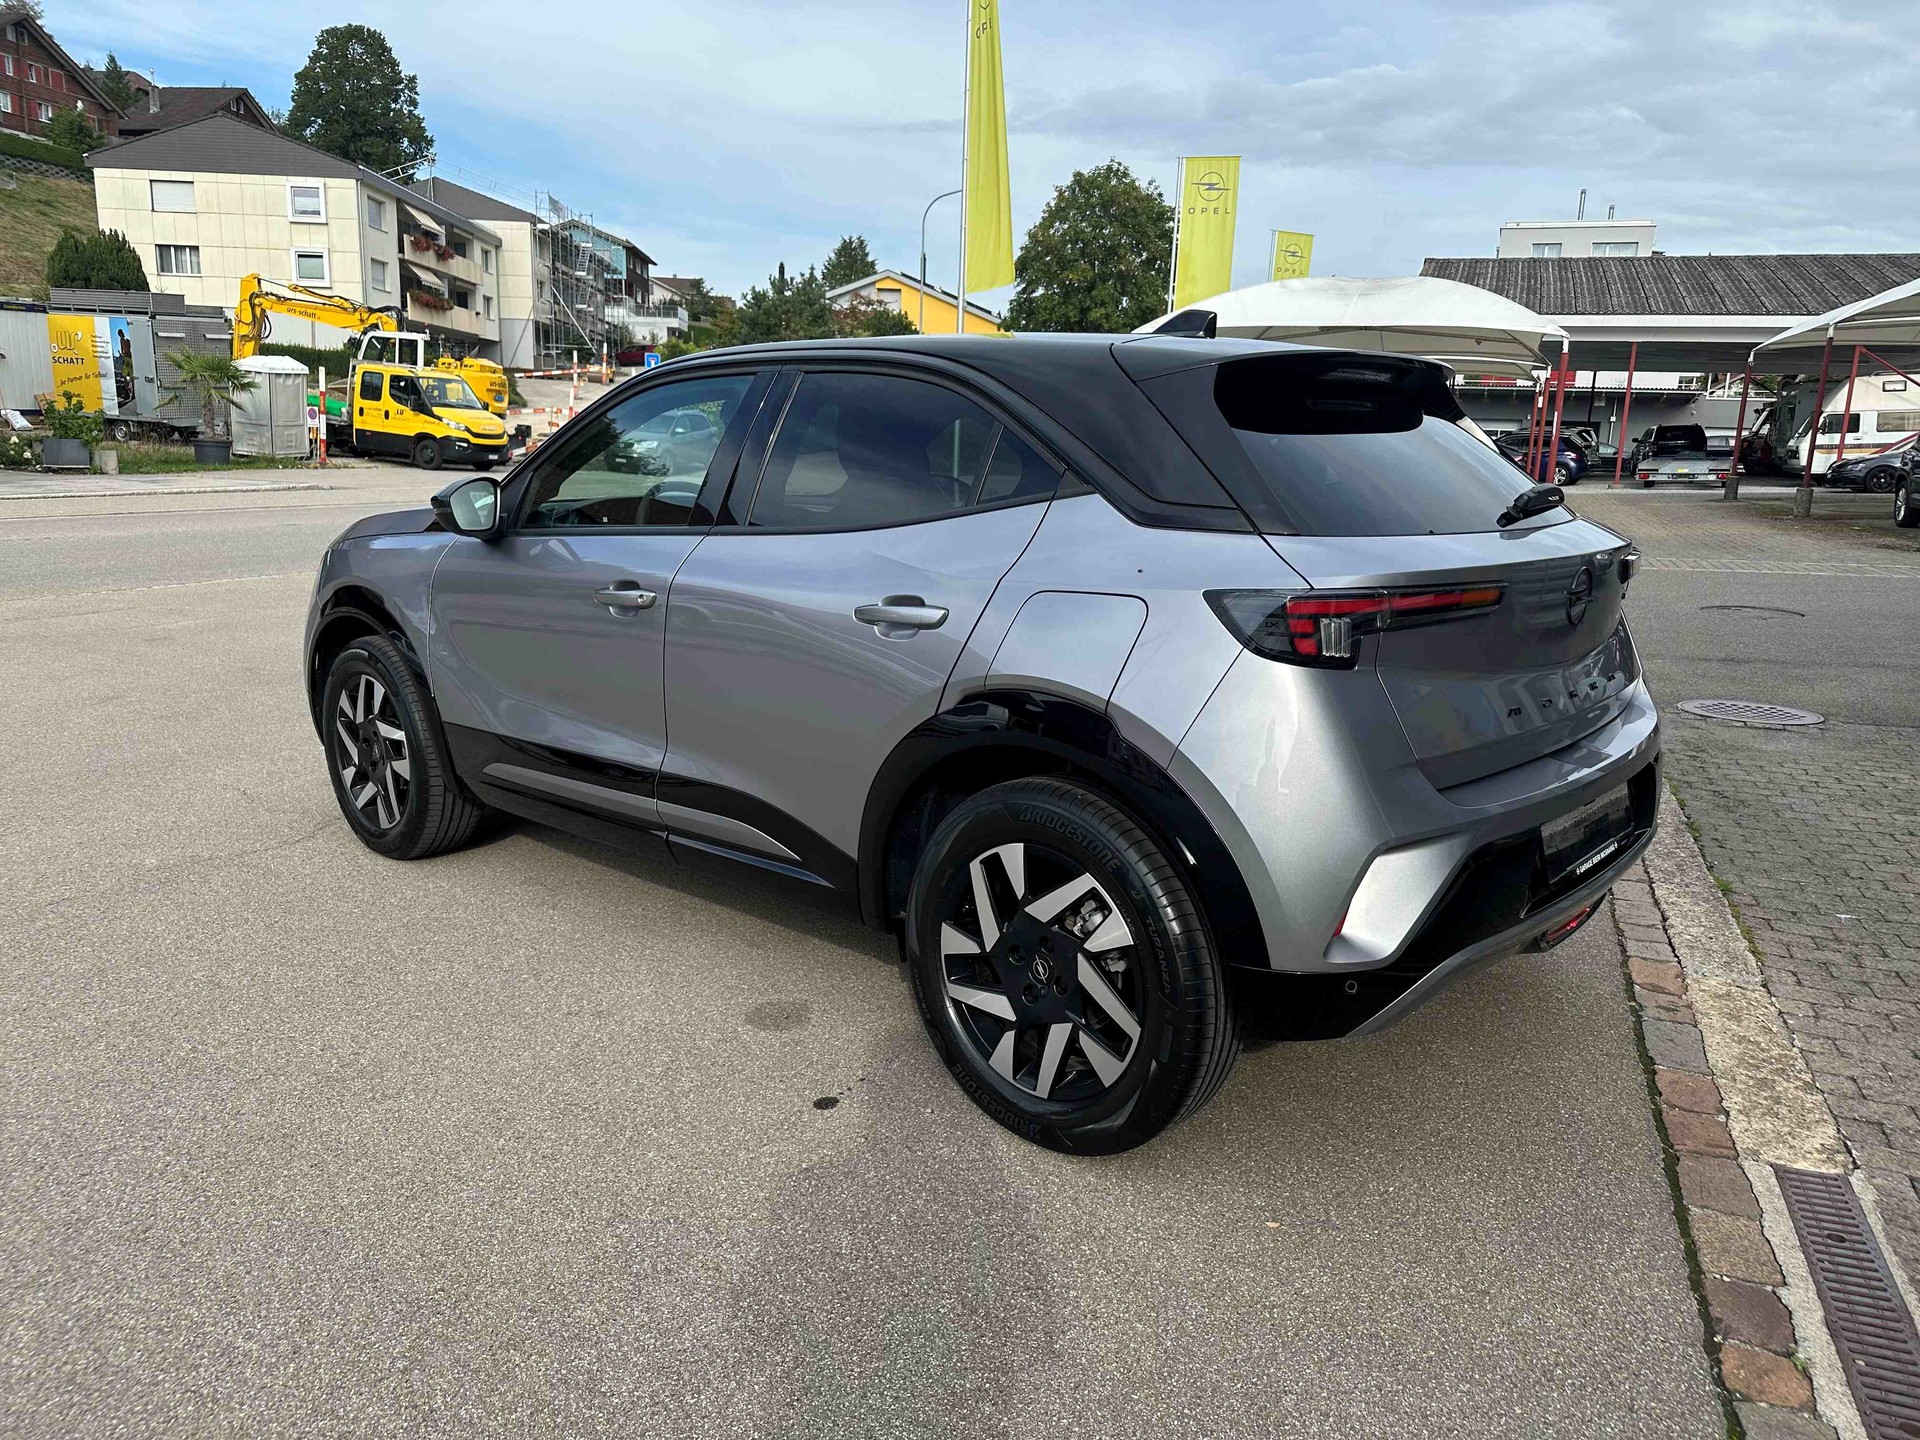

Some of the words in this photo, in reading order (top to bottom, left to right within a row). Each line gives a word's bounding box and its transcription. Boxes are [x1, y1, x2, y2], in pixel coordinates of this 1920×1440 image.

[1187, 206, 1231, 215] OPEL
[1276, 266, 1305, 275] OPEL
[52, 356, 85, 366] SCHATT
[1507, 673, 1616, 718] MOKKA
[1020, 804, 1122, 873] BRIDGESTONE
[1148, 915, 1172, 994] TURANZA
[952, 1062, 1042, 1140] BRIDGESTONE
